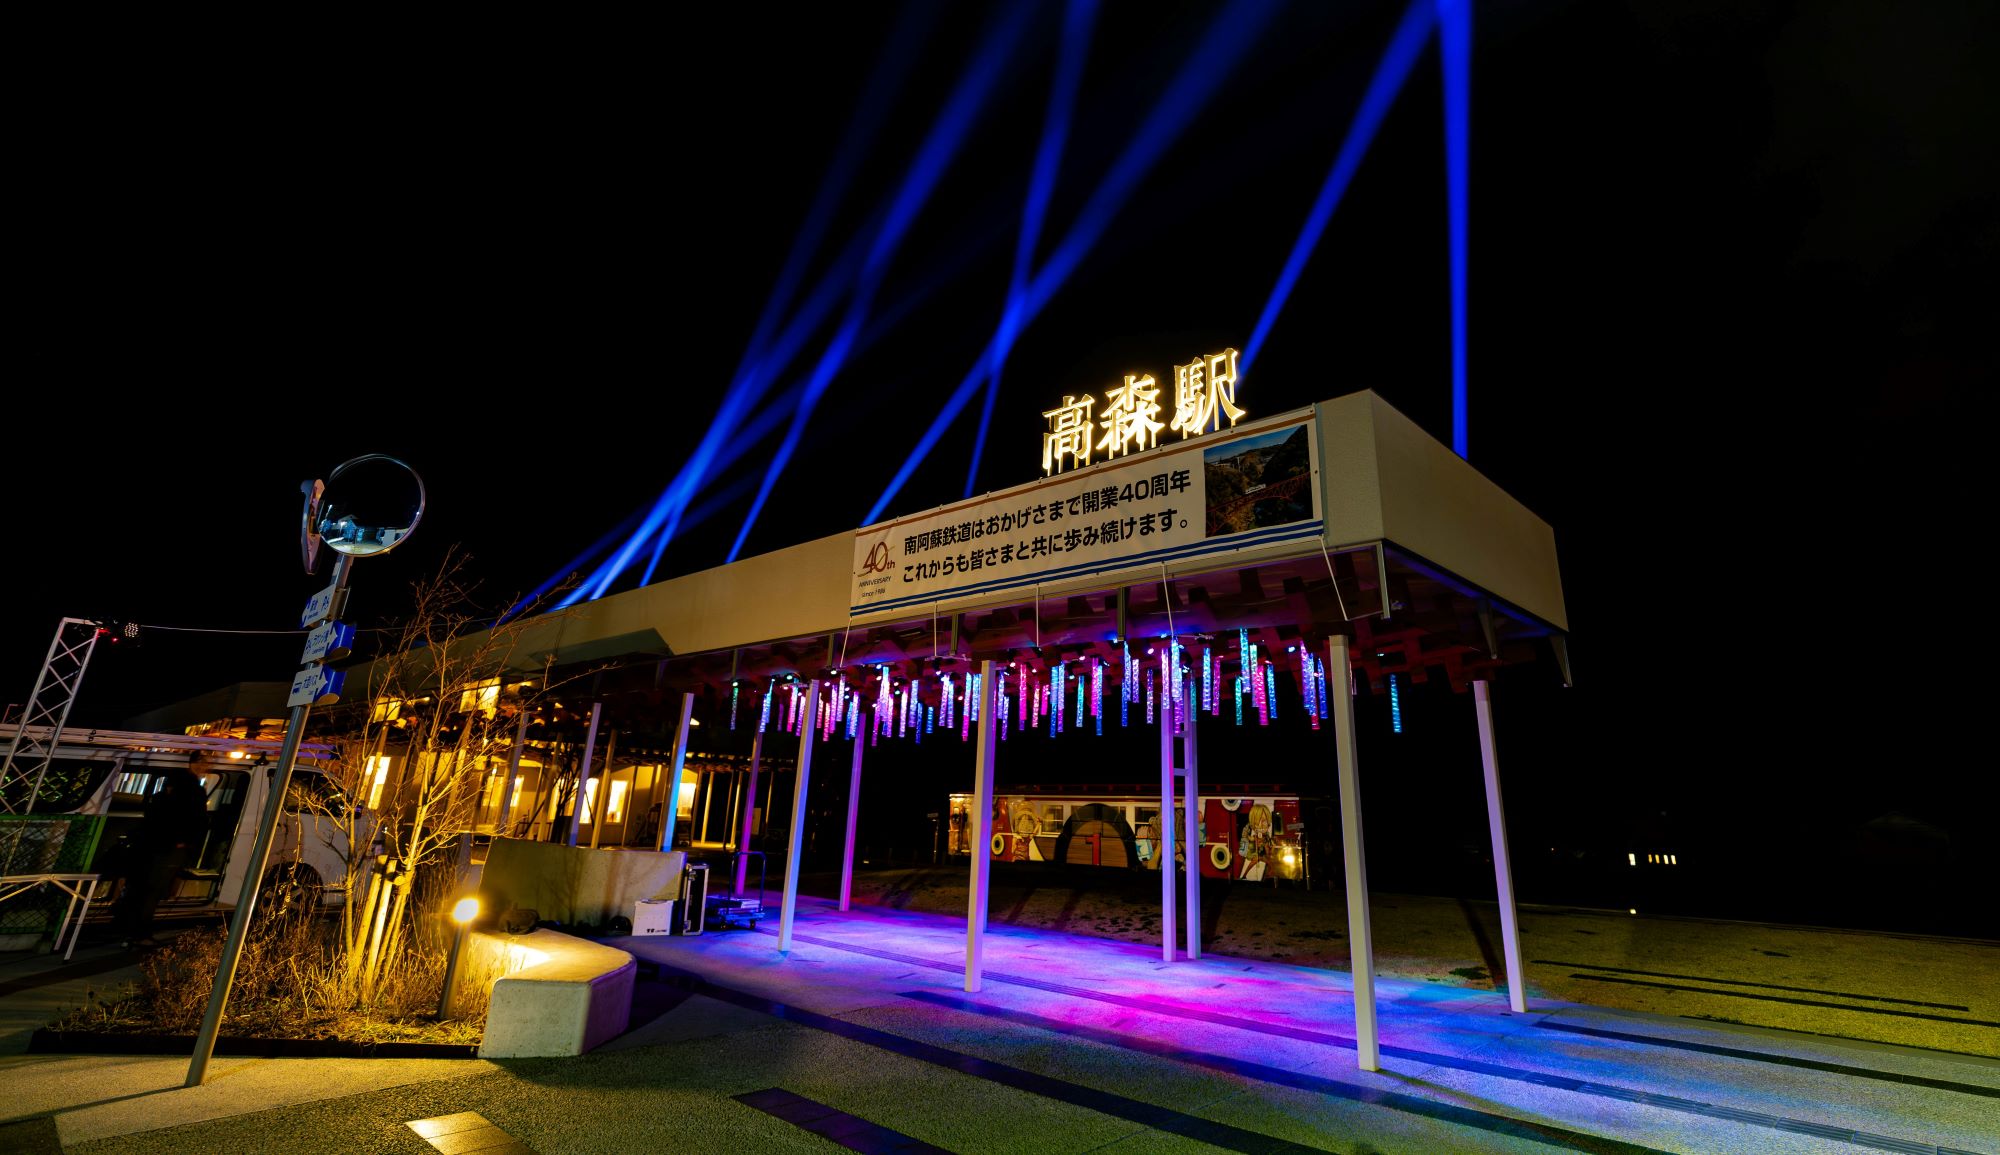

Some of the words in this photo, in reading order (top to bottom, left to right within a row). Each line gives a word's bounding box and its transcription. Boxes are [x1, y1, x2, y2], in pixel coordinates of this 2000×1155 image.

[1042, 348, 1246, 470] 高森駅
[903, 508, 1188, 583] これからも皆さまと共に歩み続けます。
[904, 469, 1192, 556] 南阿蘇鉄道はおかげさまで開業40周年
[862, 541, 896, 573] 40th
